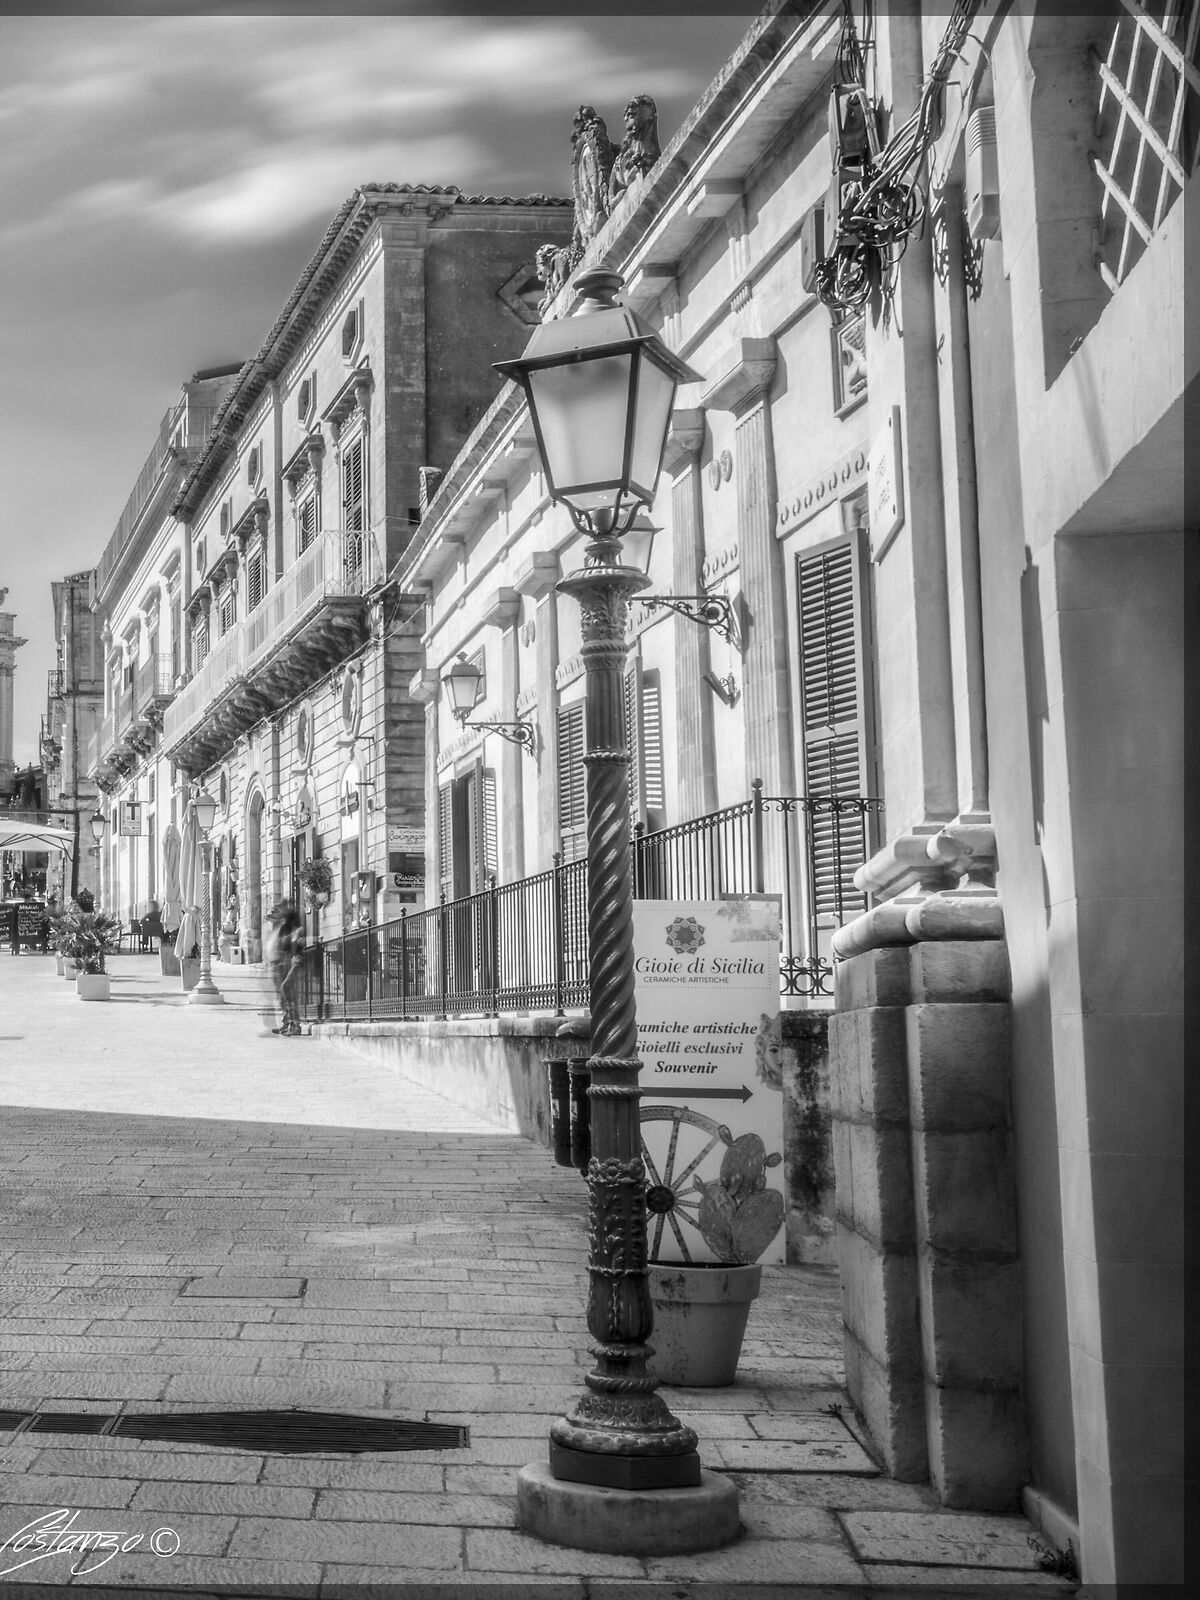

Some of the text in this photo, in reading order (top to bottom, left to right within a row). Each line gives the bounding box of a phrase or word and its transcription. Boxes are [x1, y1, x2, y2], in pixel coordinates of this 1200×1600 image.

[126, 802, 140, 821] T
[635, 956, 765, 975] Gioie di Sicilia
[643, 976, 729, 984] CERAMICHE ARTISTICHE
[636, 1021, 758, 1035] ramiche artistiche
[684, 1041, 744, 1055] esclusivi
[654, 1060, 718, 1074] Souvenir
